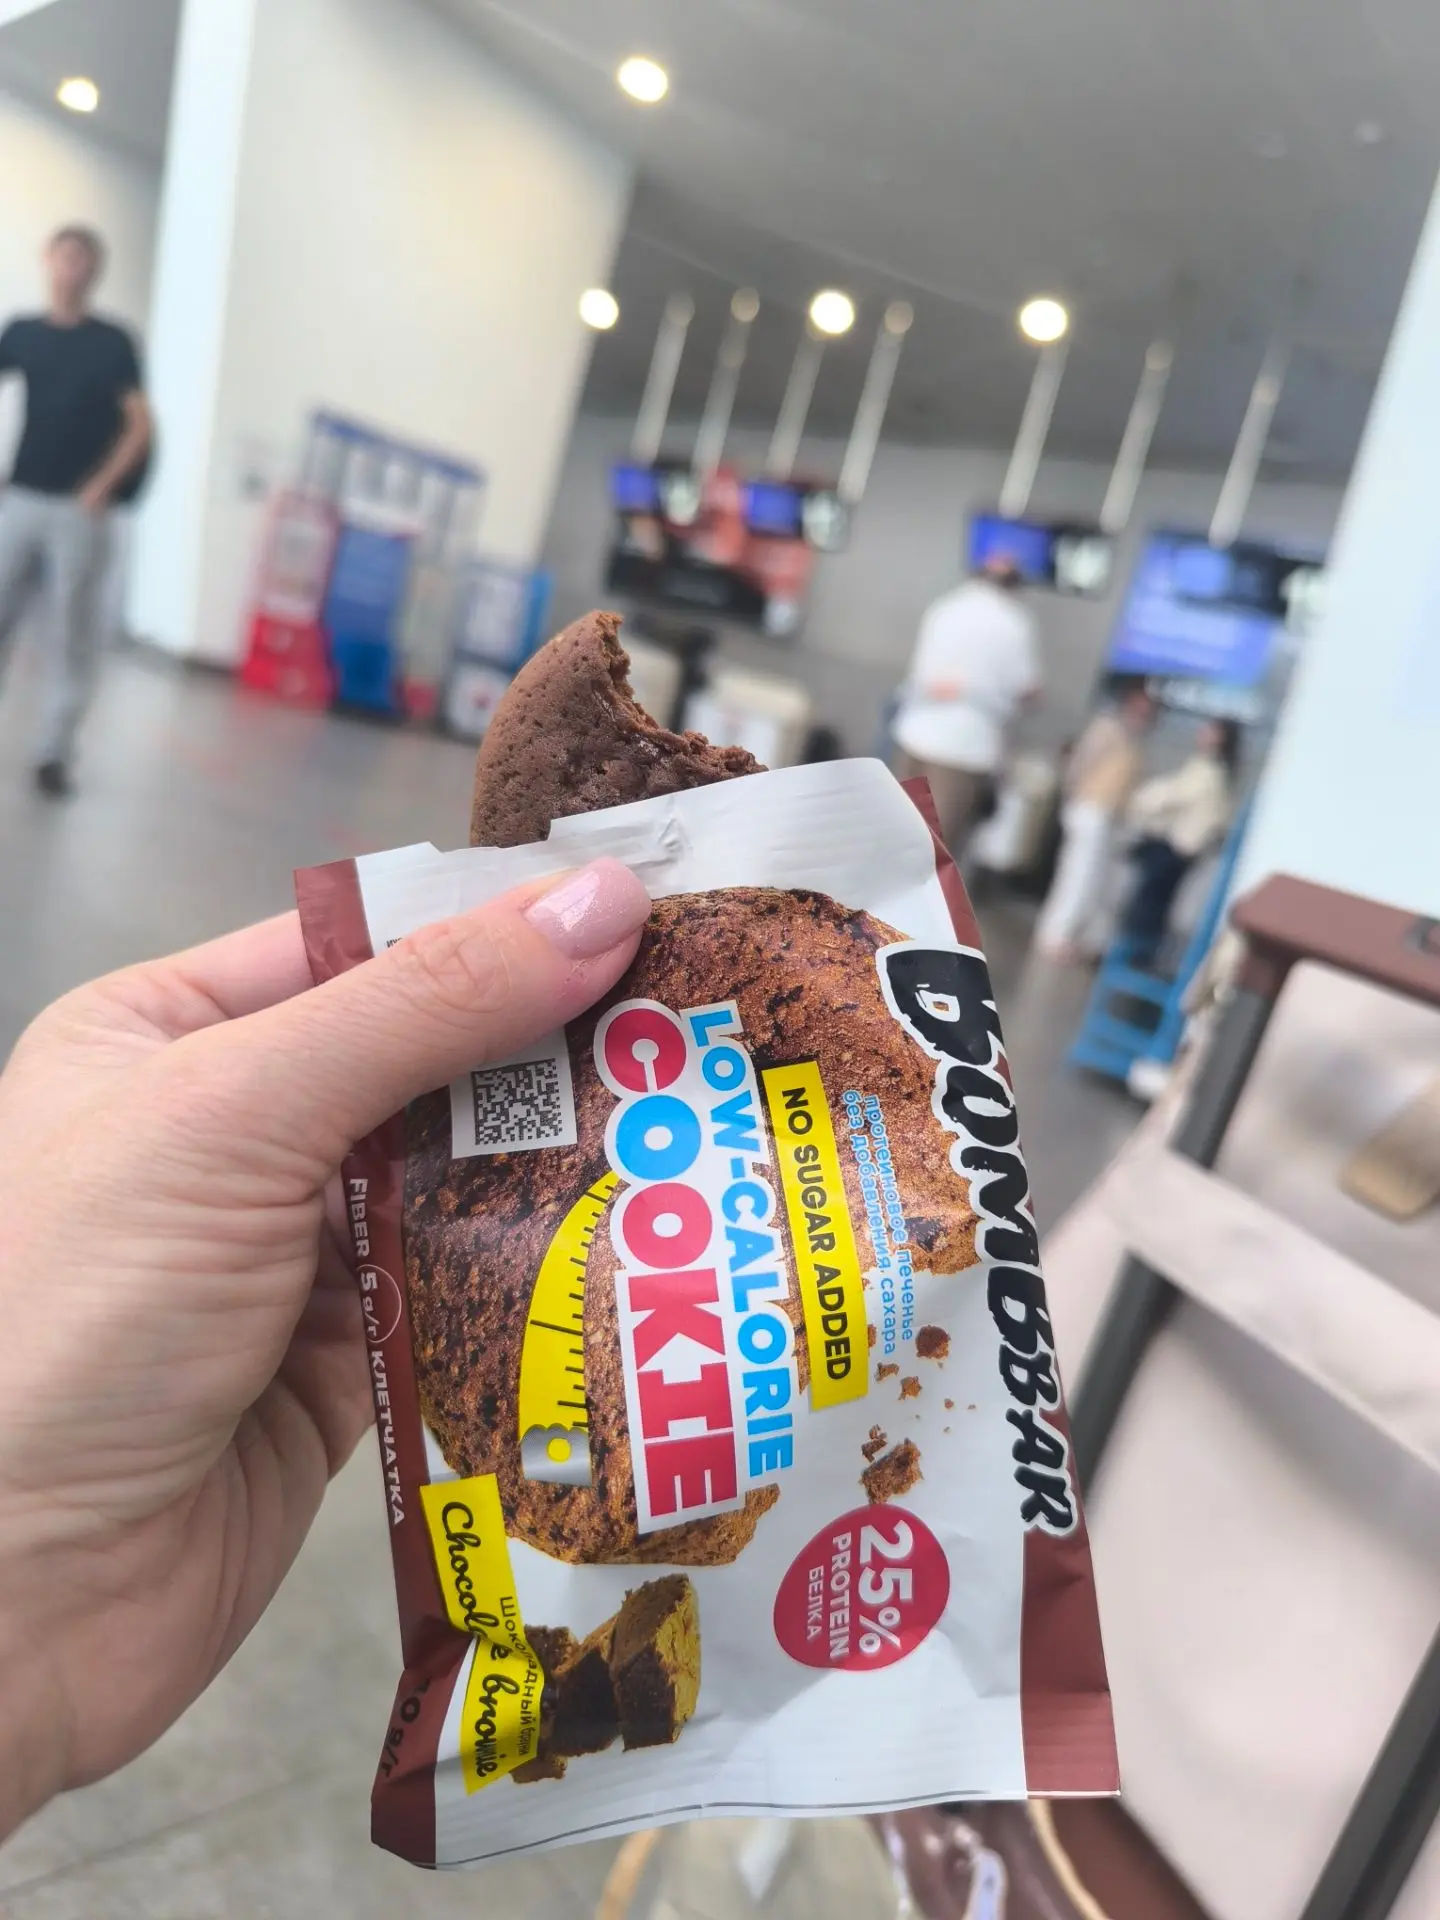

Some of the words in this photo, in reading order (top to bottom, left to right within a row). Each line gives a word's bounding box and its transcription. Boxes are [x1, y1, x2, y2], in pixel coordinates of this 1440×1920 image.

[782, 1087, 814, 1135] NO
[843, 1089, 863, 1129] без
[604, 1006, 739, 1518] COOKIE
[689, 1009, 793, 1479] LOW-CALORIE
[794, 1145, 836, 1253] SUGAR
[851, 1134, 891, 1269] добавления
[865, 1094, 907, 1244] протеиновое
[897, 1249, 914, 1341] печенье
[349, 1178, 370, 1257] FIBER
[360, 1272, 378, 1292] 5
[371, 1350, 405, 1525] КЛЕТЧАТКА
[812, 1265, 852, 1381] ADDED
[880, 1277, 896, 1355] сахара
[442, 1501, 512, 1661] Chocole
[807, 1565, 824, 1641] БЕЛКА
[829, 1532, 852, 1661] PROTEIN
[858, 1520, 914, 1654] 25%
